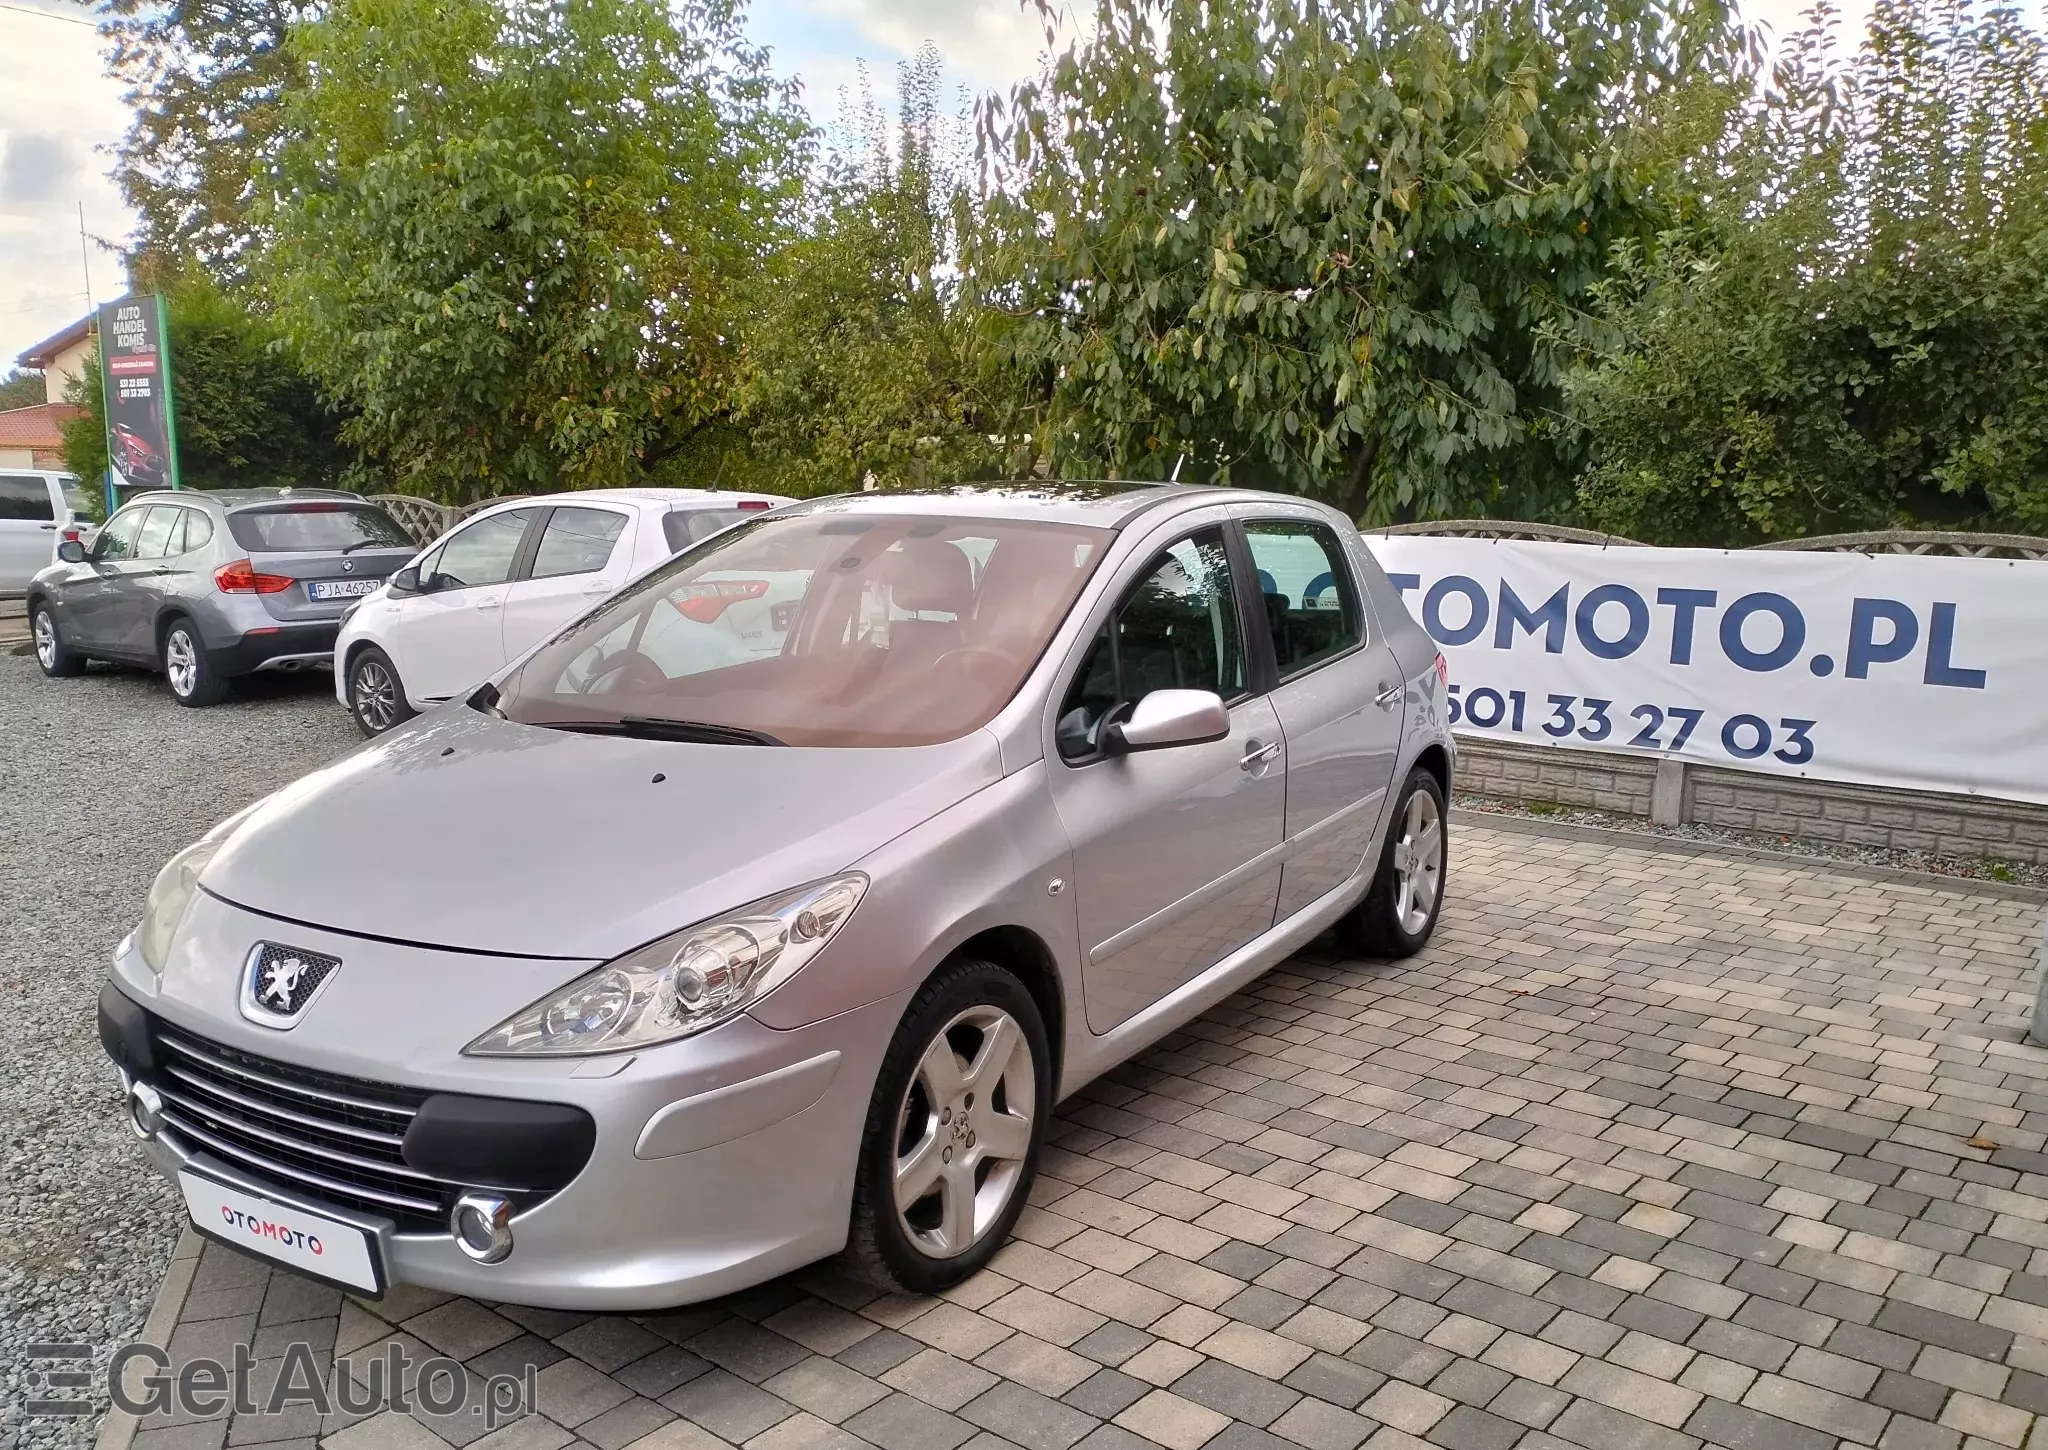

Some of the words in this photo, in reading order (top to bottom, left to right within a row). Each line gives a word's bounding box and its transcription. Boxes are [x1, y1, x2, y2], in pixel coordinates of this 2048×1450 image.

[117, 306, 140, 321] AUTO
[113, 319, 147, 335] HANDEL
[117, 333, 145, 347] KOMIS
[317, 584, 341, 597] PJA
[346, 582, 379, 595] 46257
[1386, 573, 1988, 690] OMOTO.PL
[1541, 693, 1613, 742] 33
[1627, 703, 1705, 751] 27
[1721, 713, 1818, 765] 03
[221, 1205, 323, 1256] OTOMOTO
